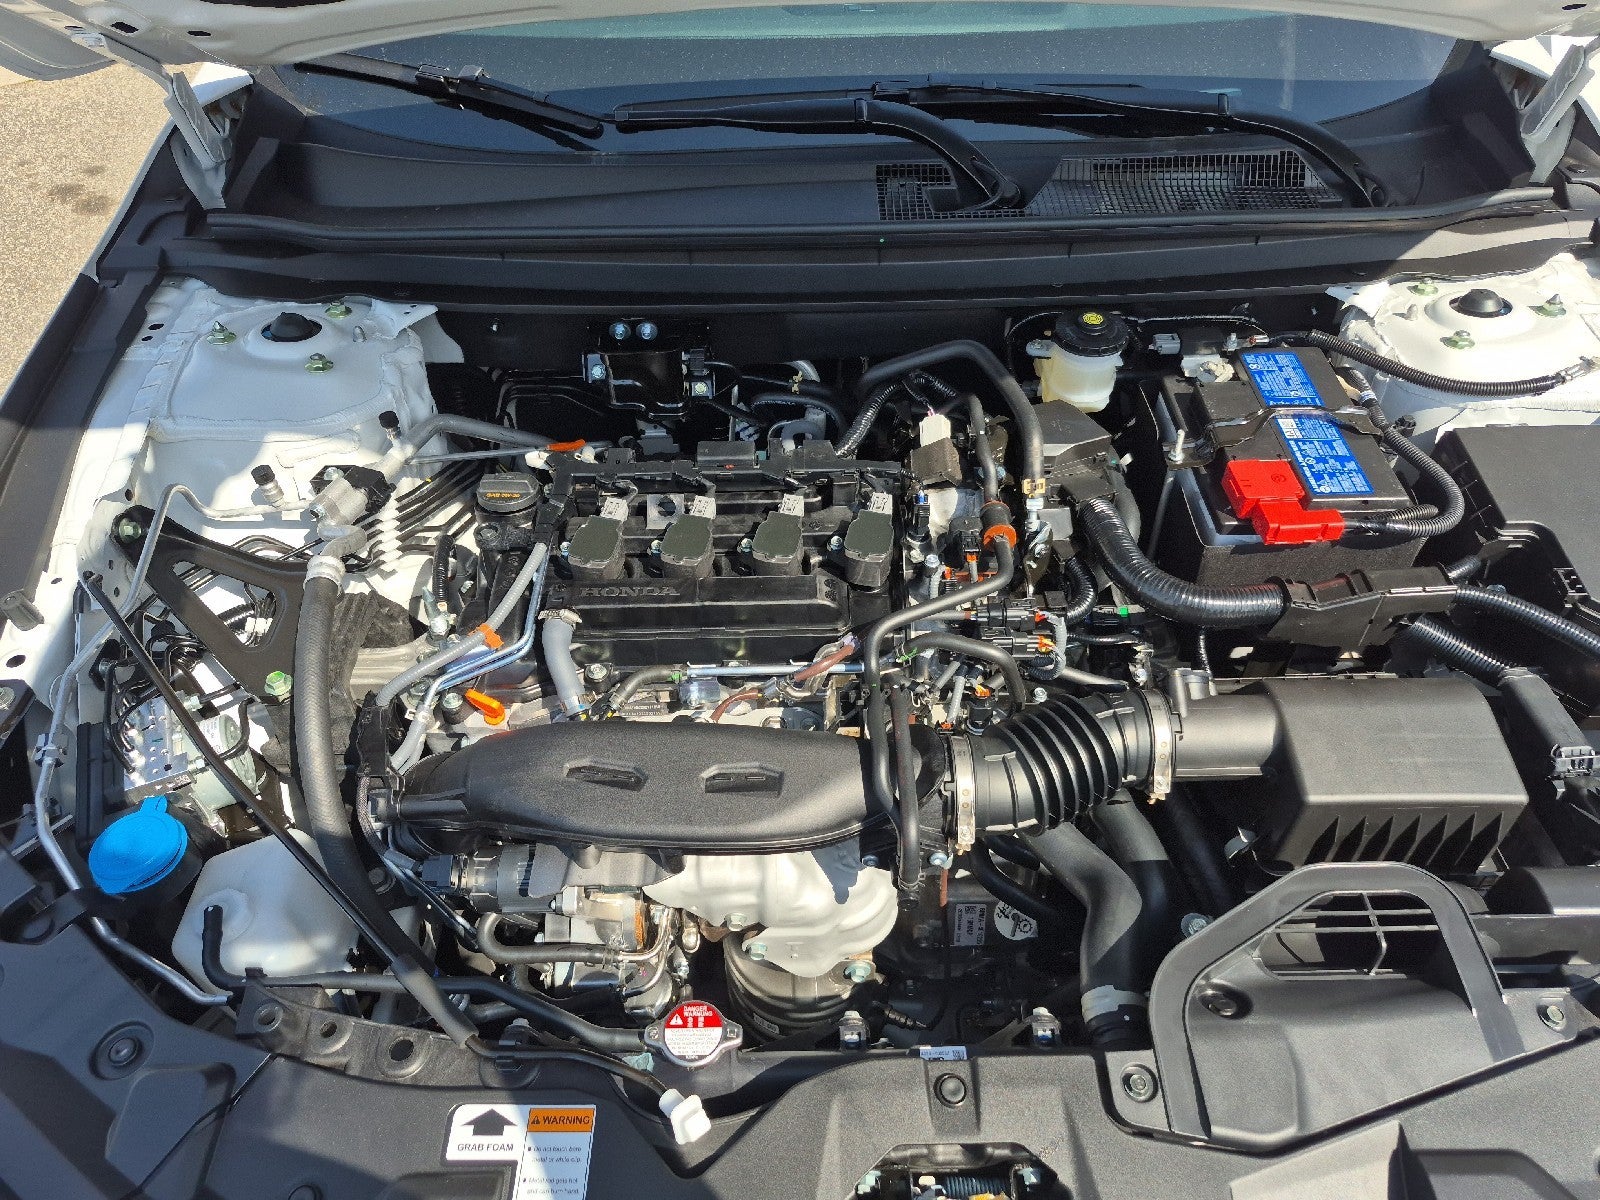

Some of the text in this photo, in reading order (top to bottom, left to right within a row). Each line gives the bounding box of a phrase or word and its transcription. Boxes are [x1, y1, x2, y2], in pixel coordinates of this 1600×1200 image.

[580, 586, 681, 597] HONDA
[542, 1115, 590, 1125] WARNING
[457, 1143, 514, 1152] GRAB FOAM
